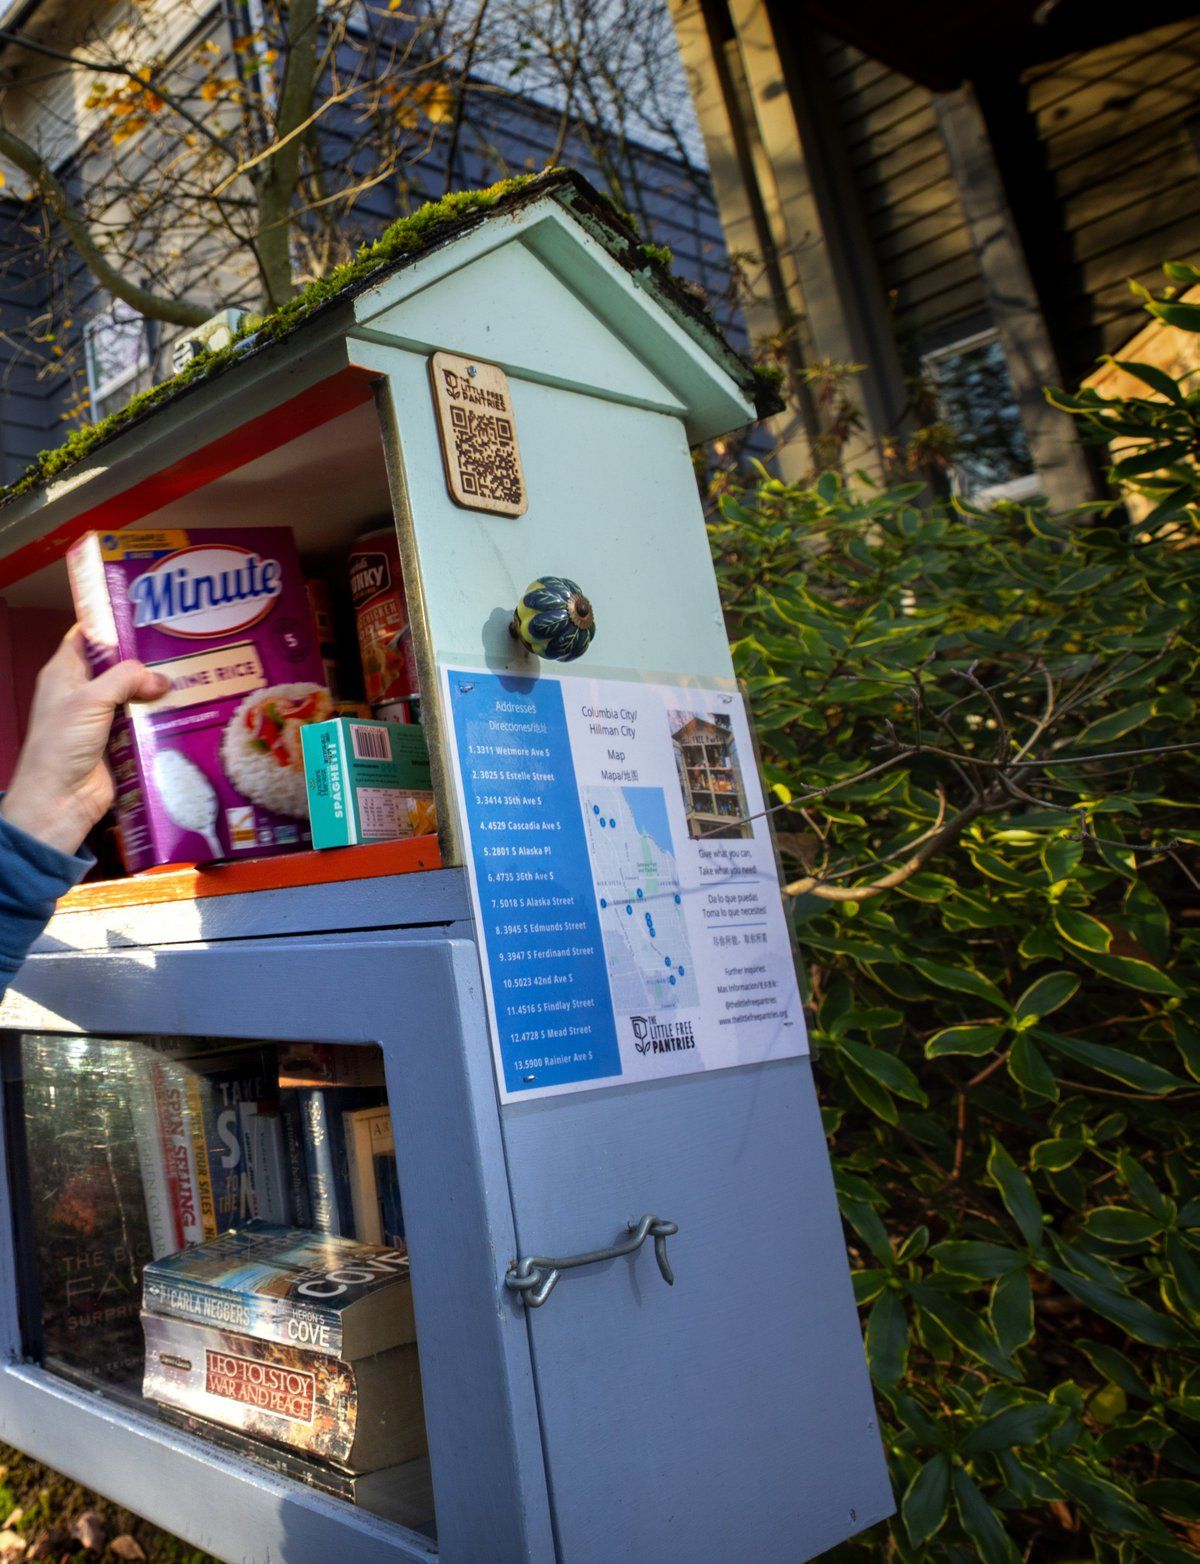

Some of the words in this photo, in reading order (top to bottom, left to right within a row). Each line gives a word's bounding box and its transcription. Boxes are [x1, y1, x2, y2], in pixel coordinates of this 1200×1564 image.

[461, 384, 484, 396] LITTLE
[486, 390, 504, 401] FREE
[461, 391, 506, 412] PANTRIES
[350, 563, 384, 594] UNKY
[132, 554, 280, 627] Minute
[214, 661, 257, 681] RICE
[495, 701, 537, 714] Addresses
[581, 706, 618, 720] Columbia
[620, 708, 637, 723] City/
[589, 724, 619, 736] Hillman
[621, 726, 636, 739] City
[496, 747, 529, 757] Wetmore
[531, 748, 544, 757] Ave
[545, 749, 550, 757] S
[607, 749, 625, 763] Map
[328, 743, 344, 819] SPAGHETTI
[500, 771, 505, 780] S
[506, 772, 531, 781] Estelle
[532, 772, 555, 782] Street
[503, 796, 521, 806] 35th
[522, 797, 535, 806] Ave
[537, 797, 542, 806] S
[508, 821, 540, 831] Cascadia
[542, 821, 555, 831] Ave
[557, 822, 561, 831] S
[512, 847, 516, 856] S
[518, 847, 542, 856] Alaska
[544, 847, 552, 855] Pl
[698, 849, 712, 859] Give
[714, 849, 728, 859] what
[729, 850, 740, 860] you
[516, 872, 533, 881] 36th
[534, 872, 548, 881] Ave
[550, 872, 554, 881] S
[699, 866, 713, 876] Take
[714, 865, 729, 876] what
[730, 866, 742, 878] you
[520, 898, 525, 907] S
[527, 898, 551, 907] Alaska
[552, 896, 574, 906] Street
[702, 909, 720, 919] Toma
[523, 924, 528, 933] S
[530, 922, 563, 933] Edmunds
[564, 921, 586, 931] Street
[527, 951, 532, 960] S
[533, 948, 570, 959] Ferdinand
[572, 947, 594, 957] Street
[534, 975, 551, 986] 42nd
[553, 974, 567, 984] Ave
[568, 973, 573, 982] S
[537, 1004, 542, 1013] S
[543, 1001, 571, 1013] Findlay
[572, 999, 595, 1009] Street
[648, 1015, 657, 1025] THE
[540, 1030, 546, 1039] S
[547, 1028, 567, 1038] Mead
[569, 1025, 592, 1035] Street
[650, 1023, 674, 1040] LITTLE
[675, 1021, 693, 1035] FREE
[653, 1035, 696, 1055] PANTRIES
[544, 1053, 572, 1066] Rainier
[573, 1052, 588, 1062] Ave
[588, 1051, 593, 1060] S
[220, 1077, 263, 1106] TAKE
[166, 1088, 185, 1137] SPIN
[195, 1144, 208, 1176] YOUR
[172, 1145, 197, 1227] SELLING
[225, 1174, 239, 1197] TO
[199, 1181, 213, 1216] SALES
[218, 1192, 239, 1214] THE
[149, 1194, 166, 1251] COLLAR
[62, 1250, 104, 1270] THE
[298, 1252, 411, 1298] COVE
[65, 1271, 131, 1308] FA
[170, 1290, 201, 1314] CARLA
[203, 1297, 251, 1327] NEGGERS
[292, 1308, 325, 1325] HERON'S
[287, 1318, 331, 1348] COVE
[210, 1352, 238, 1379] LEO
[242, 1364, 310, 1397] TOLSTOY
[208, 1374, 237, 1398] WAR
[238, 1383, 269, 1406] AND
[269, 1390, 311, 1419] PEACE
